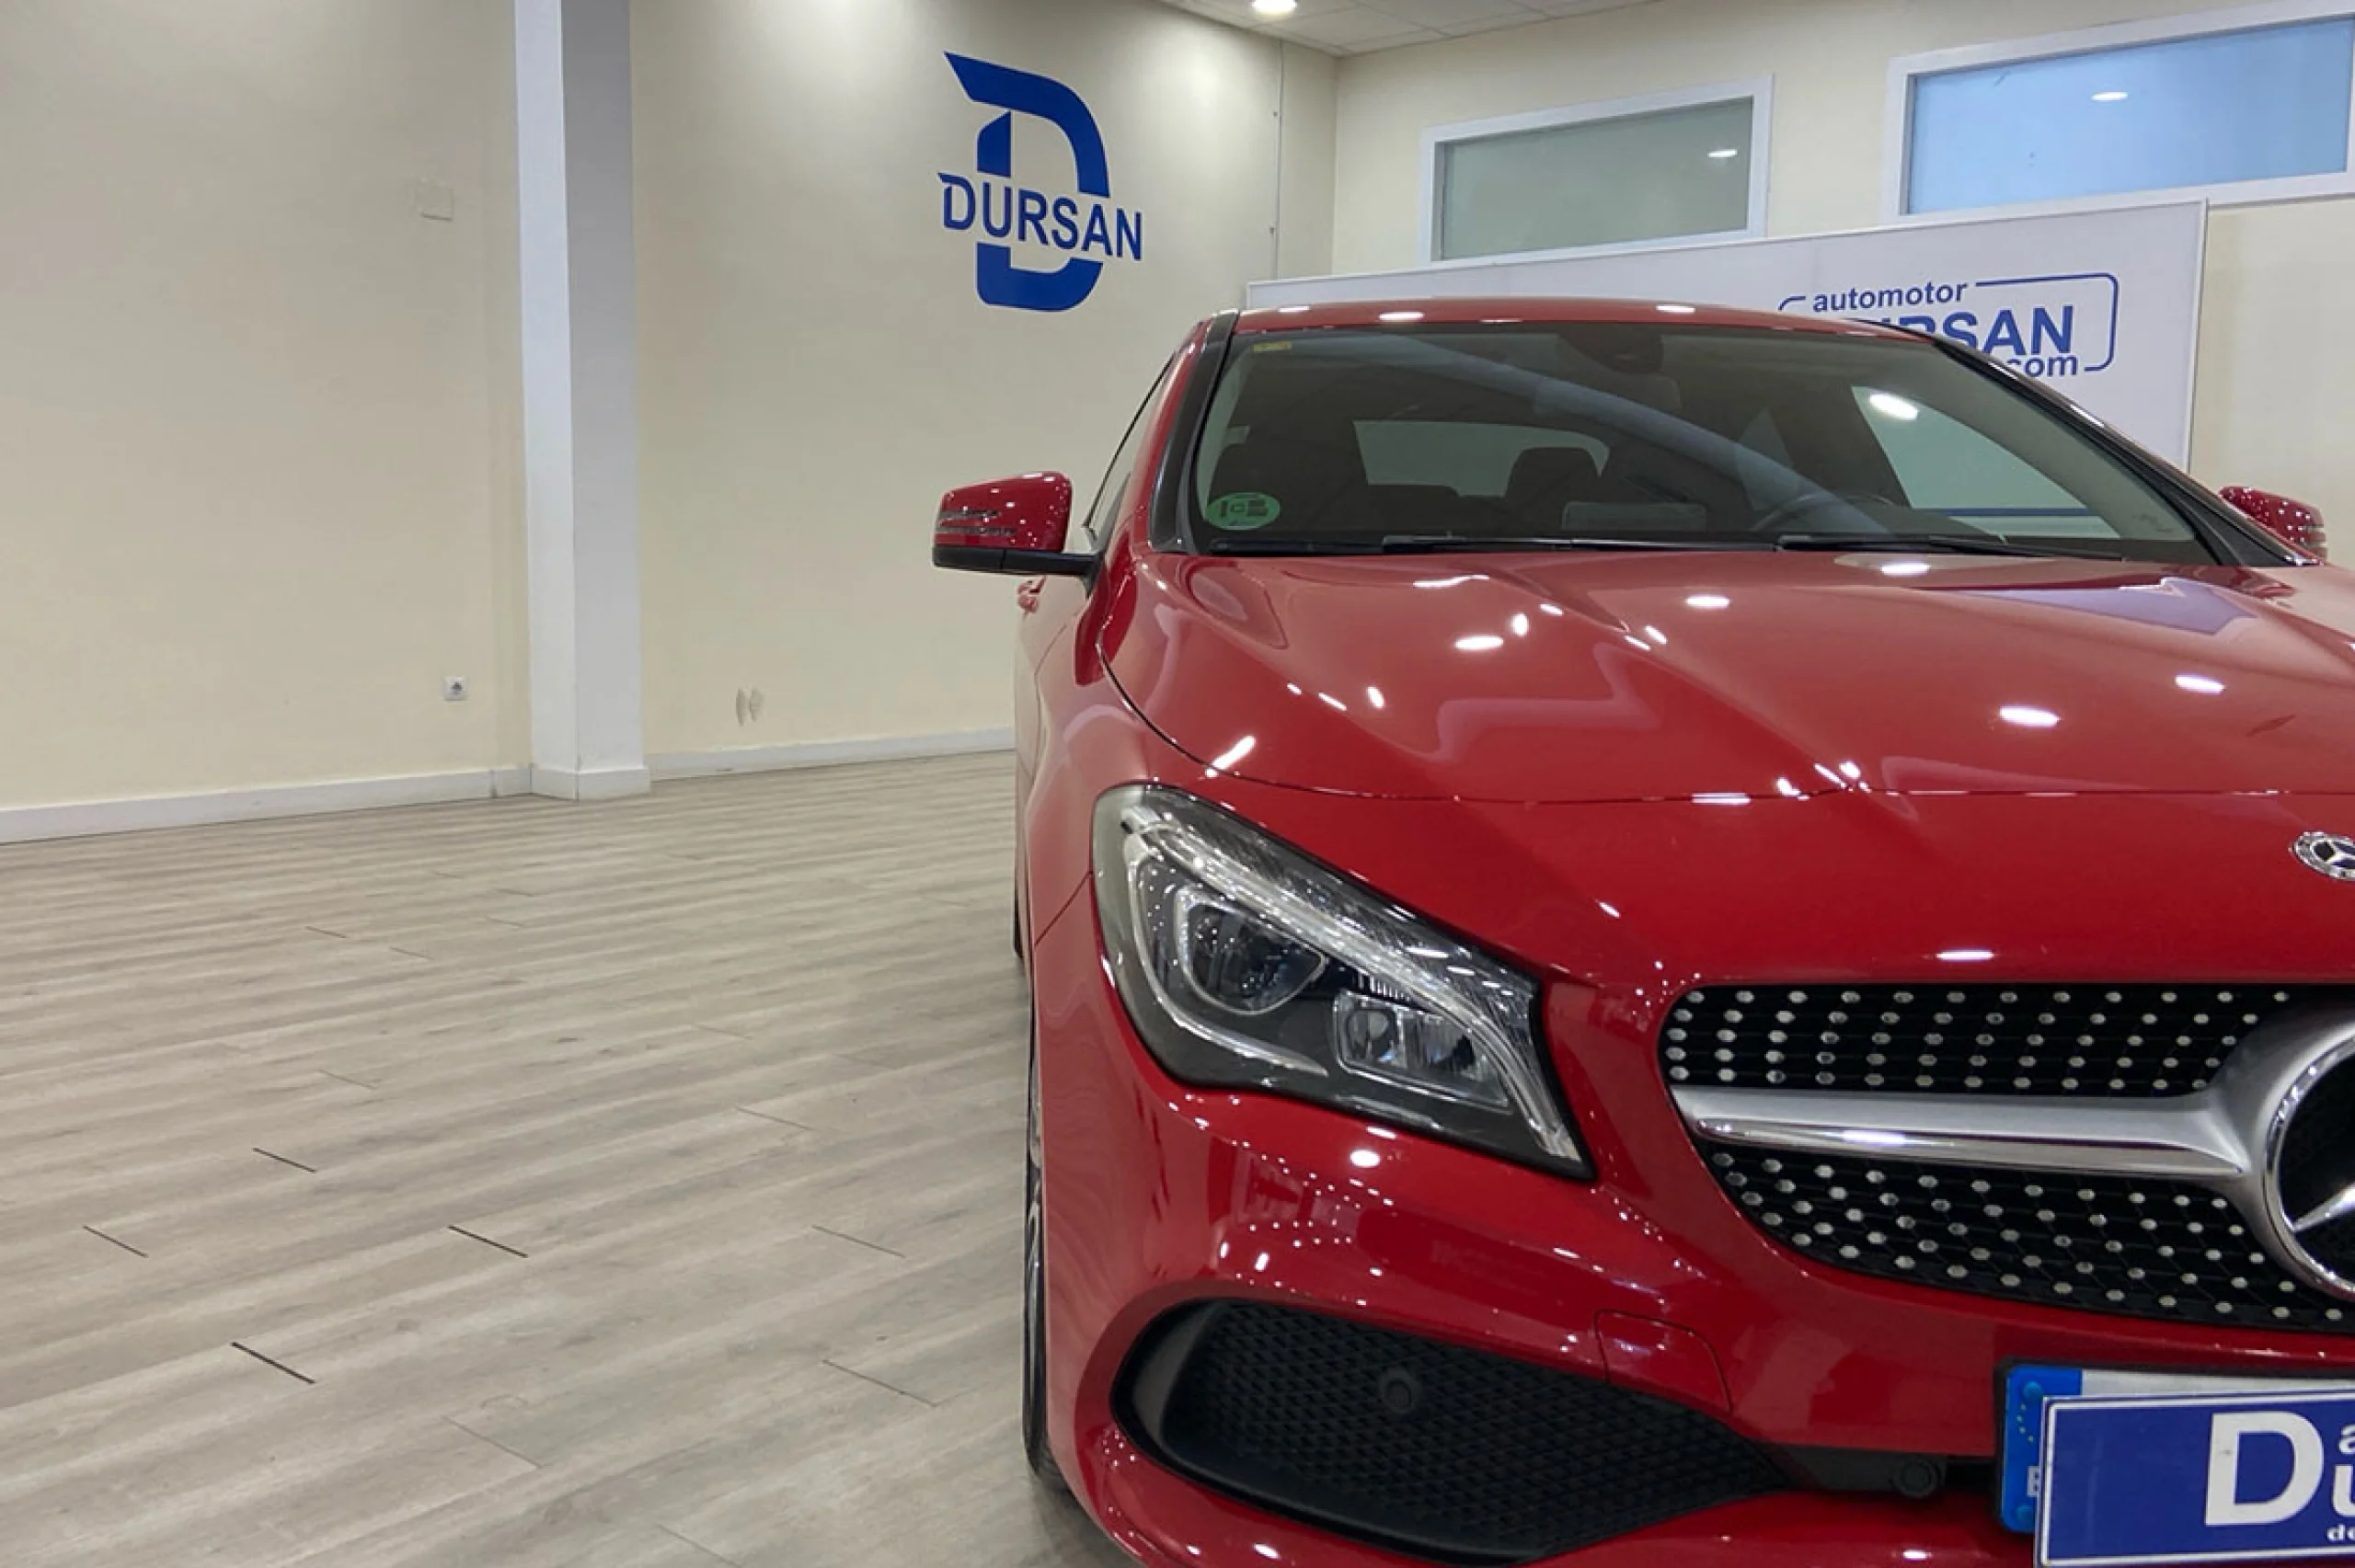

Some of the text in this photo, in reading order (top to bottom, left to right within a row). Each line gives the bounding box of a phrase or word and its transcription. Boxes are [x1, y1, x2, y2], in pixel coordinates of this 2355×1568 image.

[937, 172, 1142, 261] DURSAN
[1812, 281, 1969, 313] automotor
[1880, 305, 2074, 355] SAN
